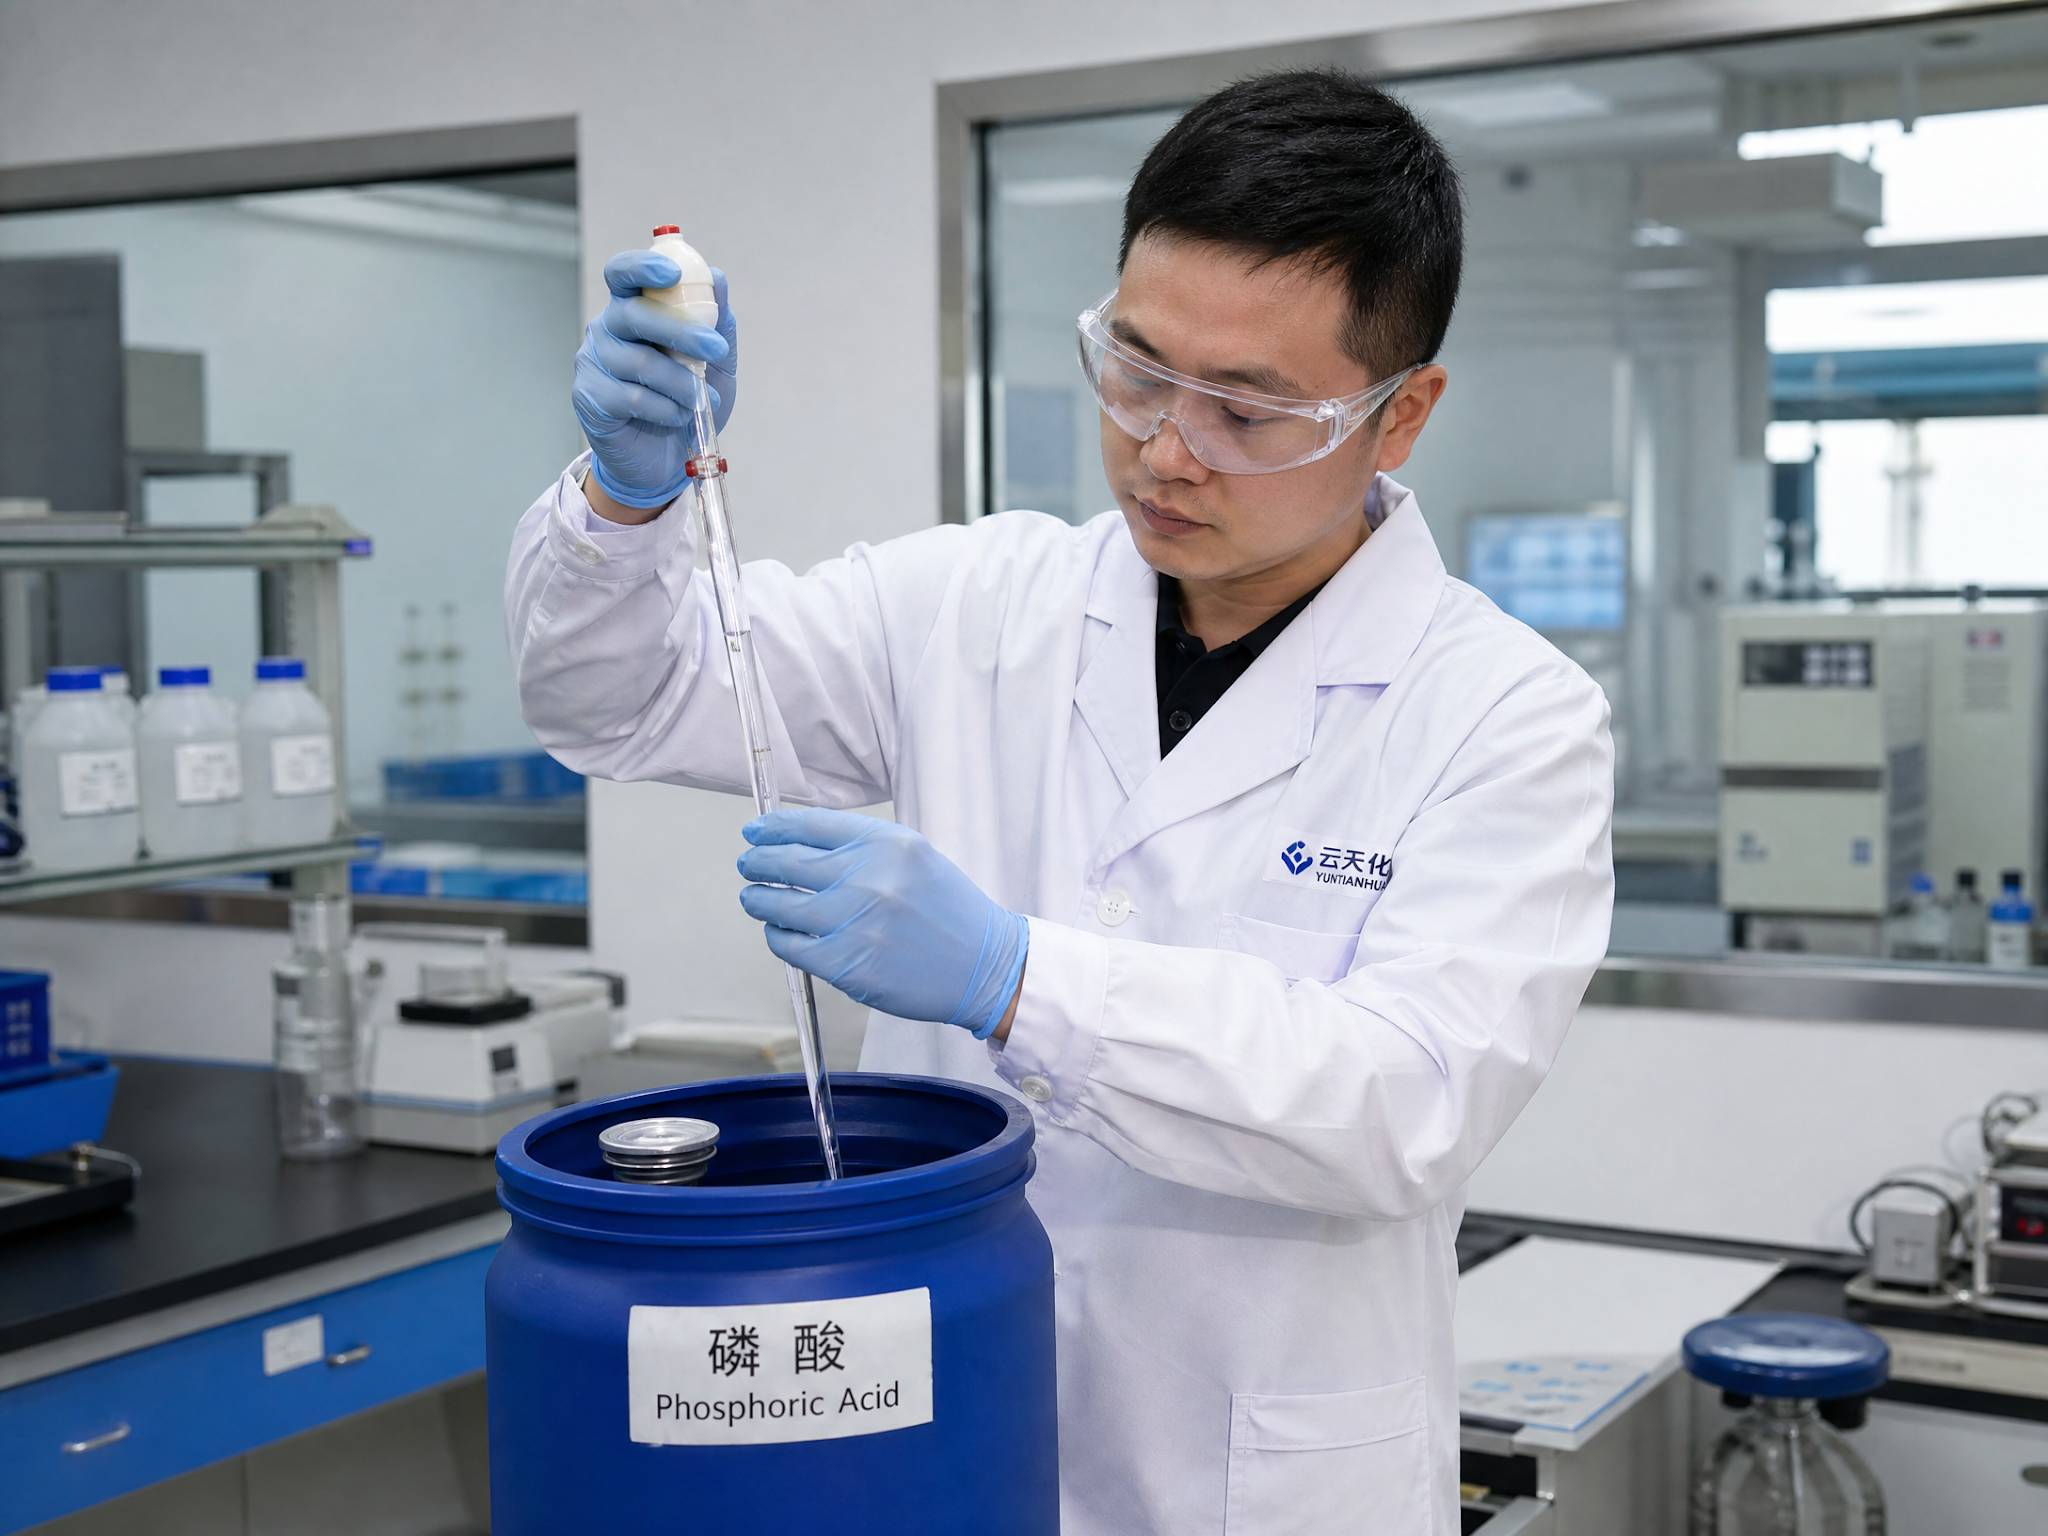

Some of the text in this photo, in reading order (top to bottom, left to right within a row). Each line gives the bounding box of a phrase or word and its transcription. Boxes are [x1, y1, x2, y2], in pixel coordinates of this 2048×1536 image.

[1319, 846, 1392, 877] 云天化
[708, 1320, 845, 1377] 磷酸
[656, 1380, 899, 1427] Phosphoric Acid
